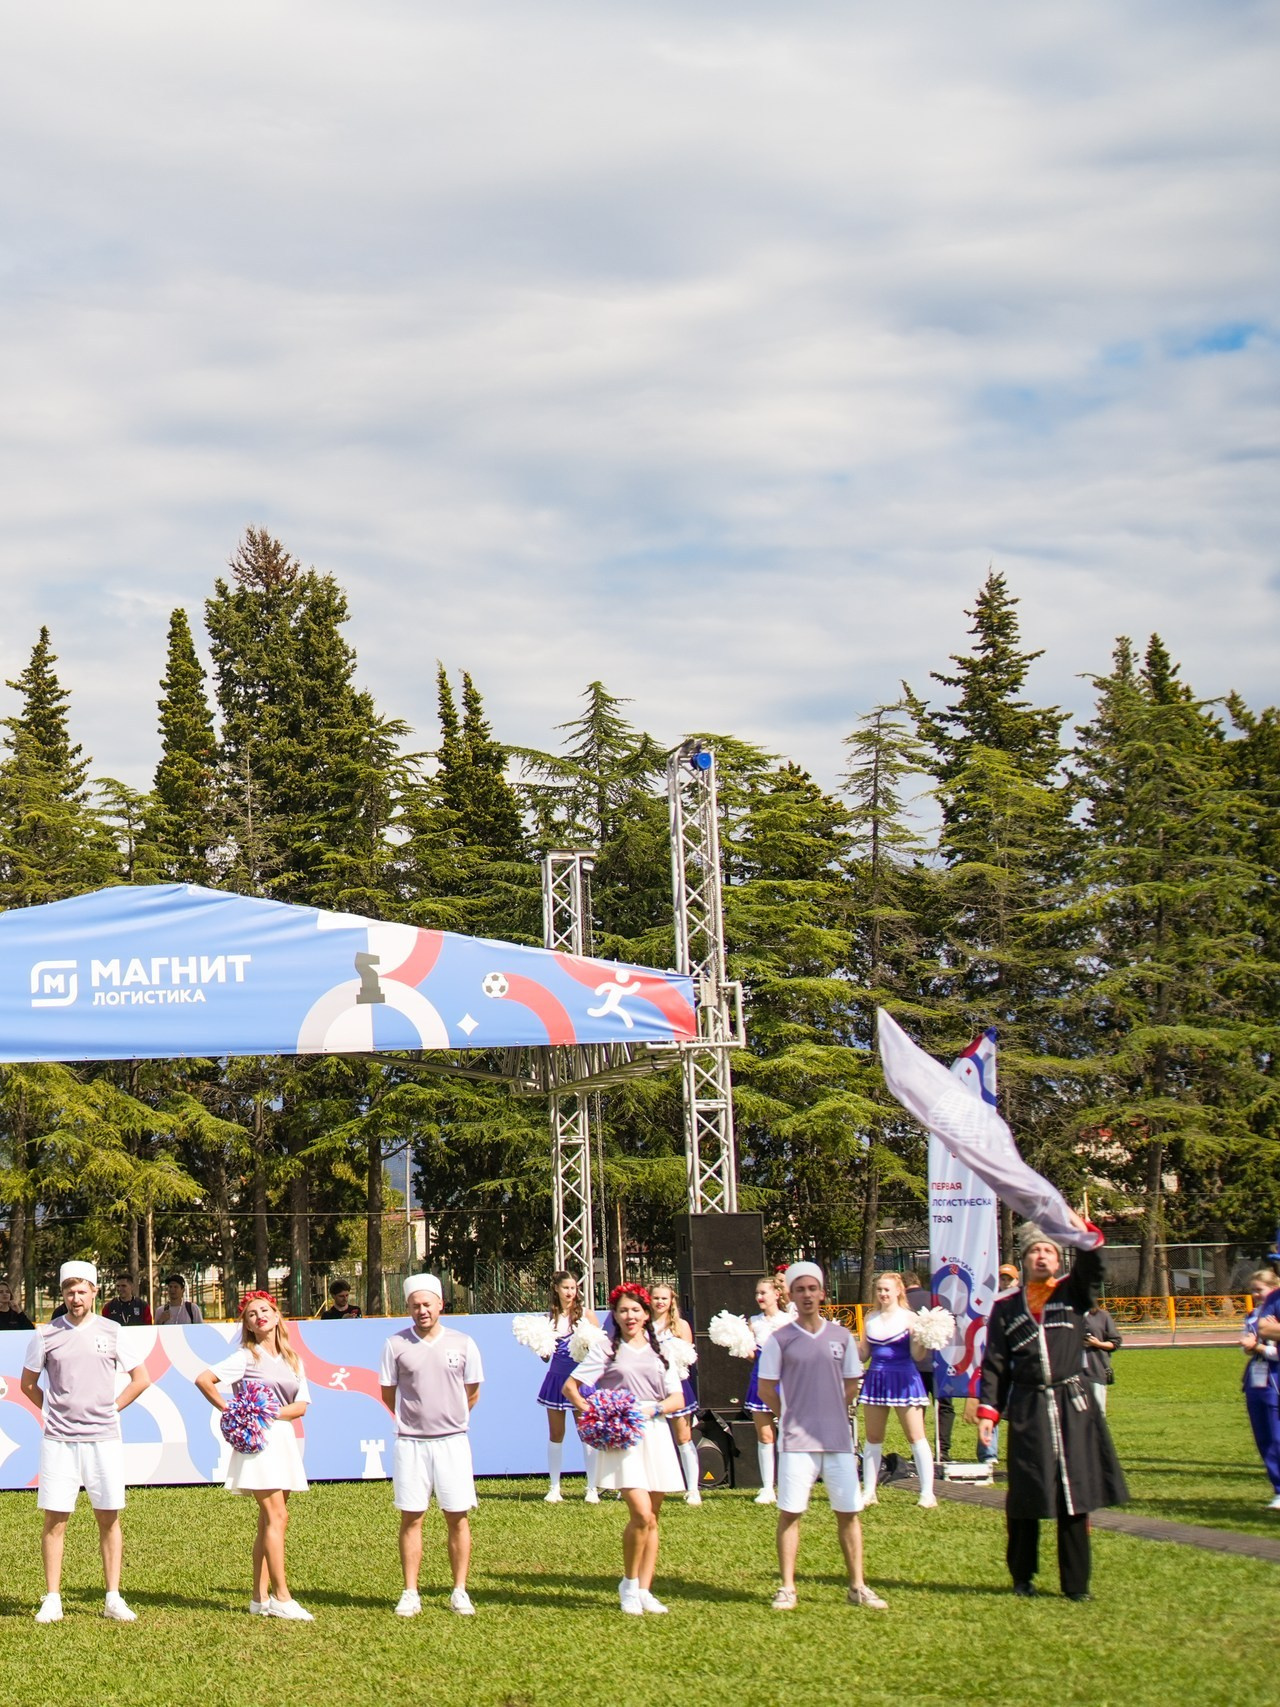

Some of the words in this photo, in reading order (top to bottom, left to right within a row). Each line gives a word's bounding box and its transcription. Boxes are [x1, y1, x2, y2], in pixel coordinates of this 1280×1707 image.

[91, 954, 252, 987] МАГНИТ
[92, 988, 207, 1006] ЛОГИСТИКА
[931, 1182, 962, 1190] ПЕРВАЯ
